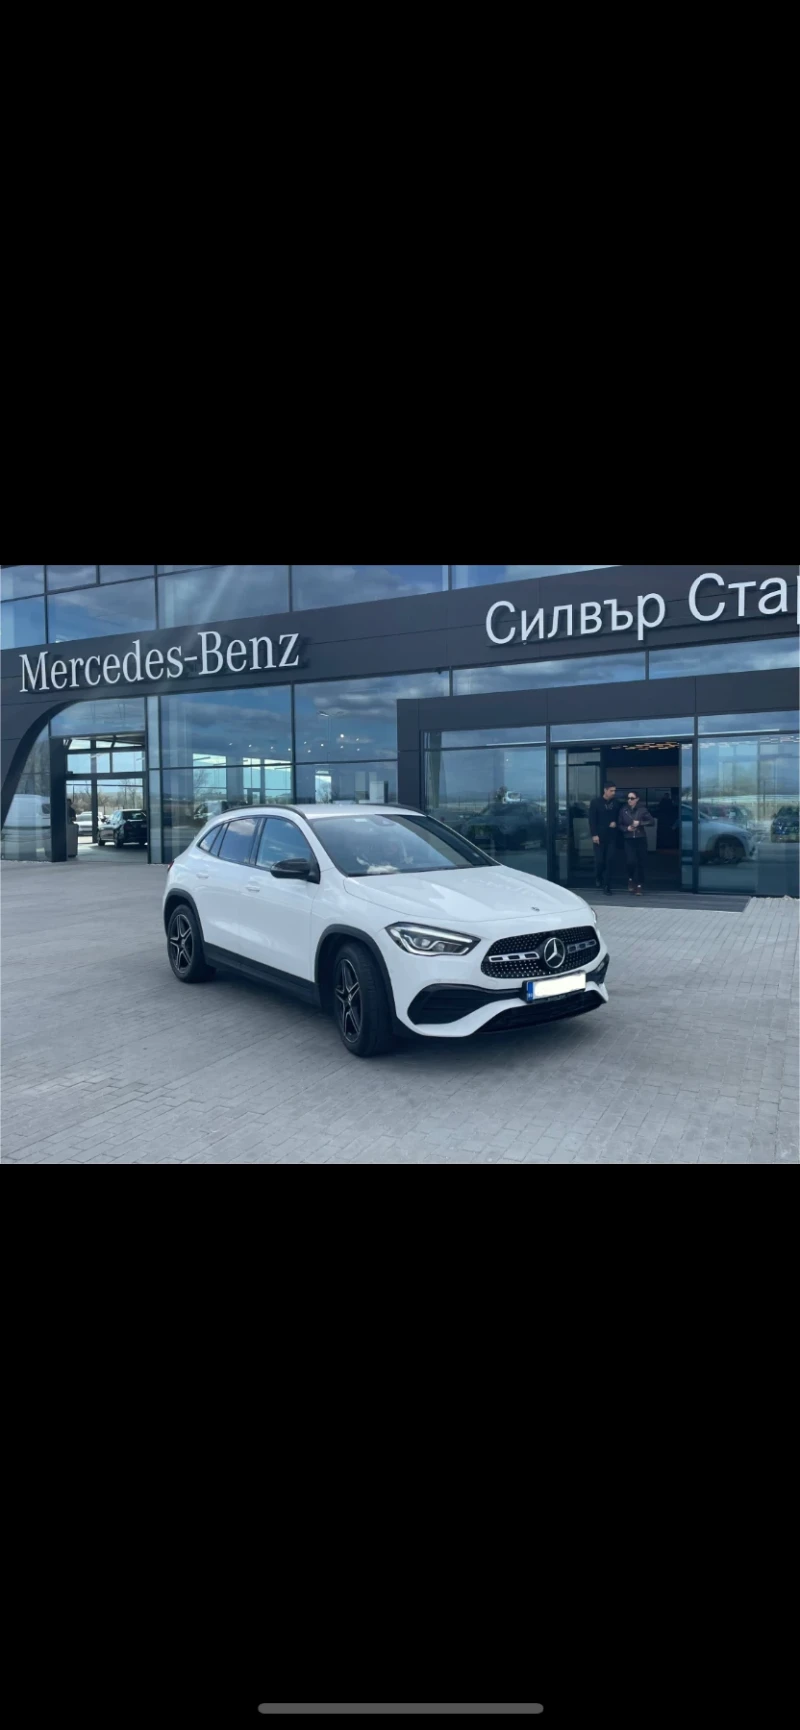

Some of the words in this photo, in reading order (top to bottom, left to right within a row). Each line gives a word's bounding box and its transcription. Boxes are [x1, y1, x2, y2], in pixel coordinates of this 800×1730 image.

[485, 592, 666, 645] Силвър
[687, 572, 800, 625] Ста
[19, 631, 300, 693] Mercedes-Benz
